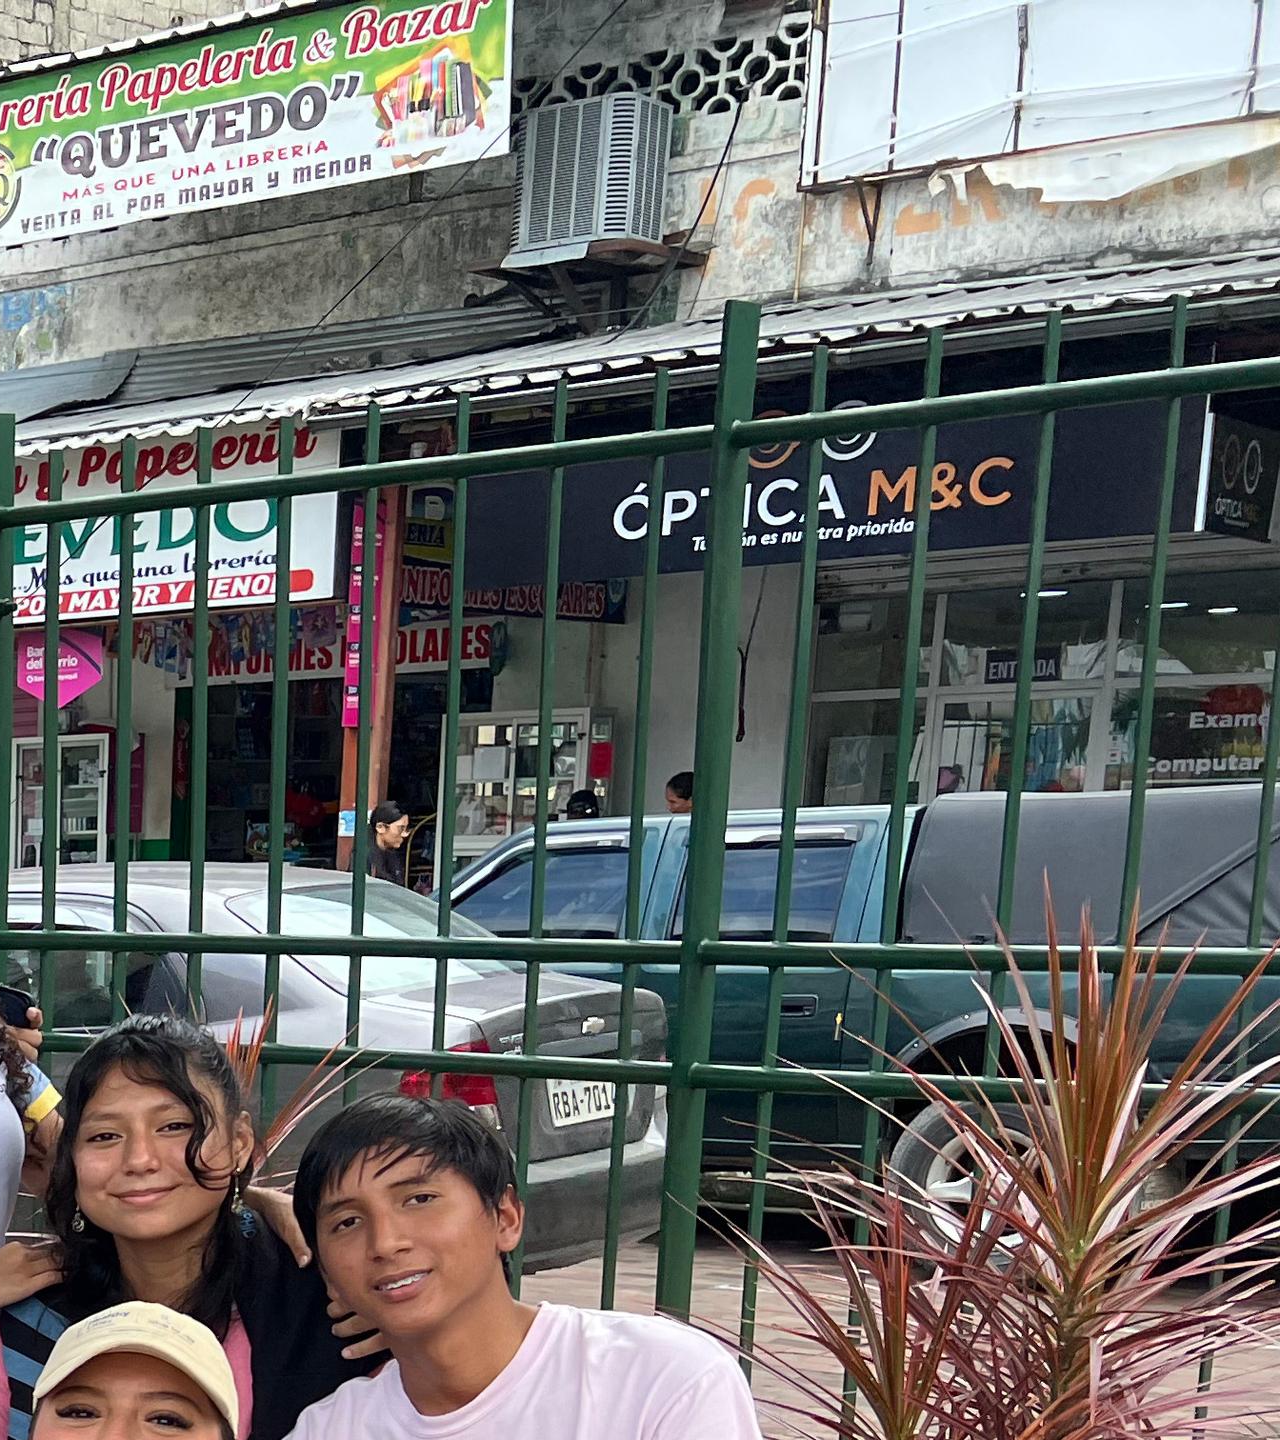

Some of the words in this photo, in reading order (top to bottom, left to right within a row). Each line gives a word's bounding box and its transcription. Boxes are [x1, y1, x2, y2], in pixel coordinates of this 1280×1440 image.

[98, 29, 294, 110] Papelería
[306, 32, 332, 62] &
[343, 0, 491, 55] Bazar
[114, 173, 156, 191] QUE
[172, 162, 216, 181] UNA
[226, 140, 328, 170] LIBRERÍA
[21, 208, 81, 234] VENTA
[93, 202, 115, 220] AL
[127, 192, 165, 214] POR
[179, 176, 253, 205] MAYOR
[294, 154, 372, 184] MENOR
[77, 420, 318, 491] Papeería
[612, 474, 846, 541] ÓPICA
[868, 456, 1015, 517] M&C
[761, 532, 778, 545] es
[782, 524, 844, 544] nutra
[847, 517, 915, 542] priorida
[183, 549, 278, 577] lirería
[15, 593, 64, 618] PO
[168, 581, 186, 602] Y
[190, 574, 277, 600] ENO
[503, 582, 605, 618] ESCOARES
[989, 659, 1056, 680] ENTADA
[1190, 711, 1272, 729] Exame
[1146, 756, 1263, 776] Computar
[552, 1083, 616, 1120] RBA-701
